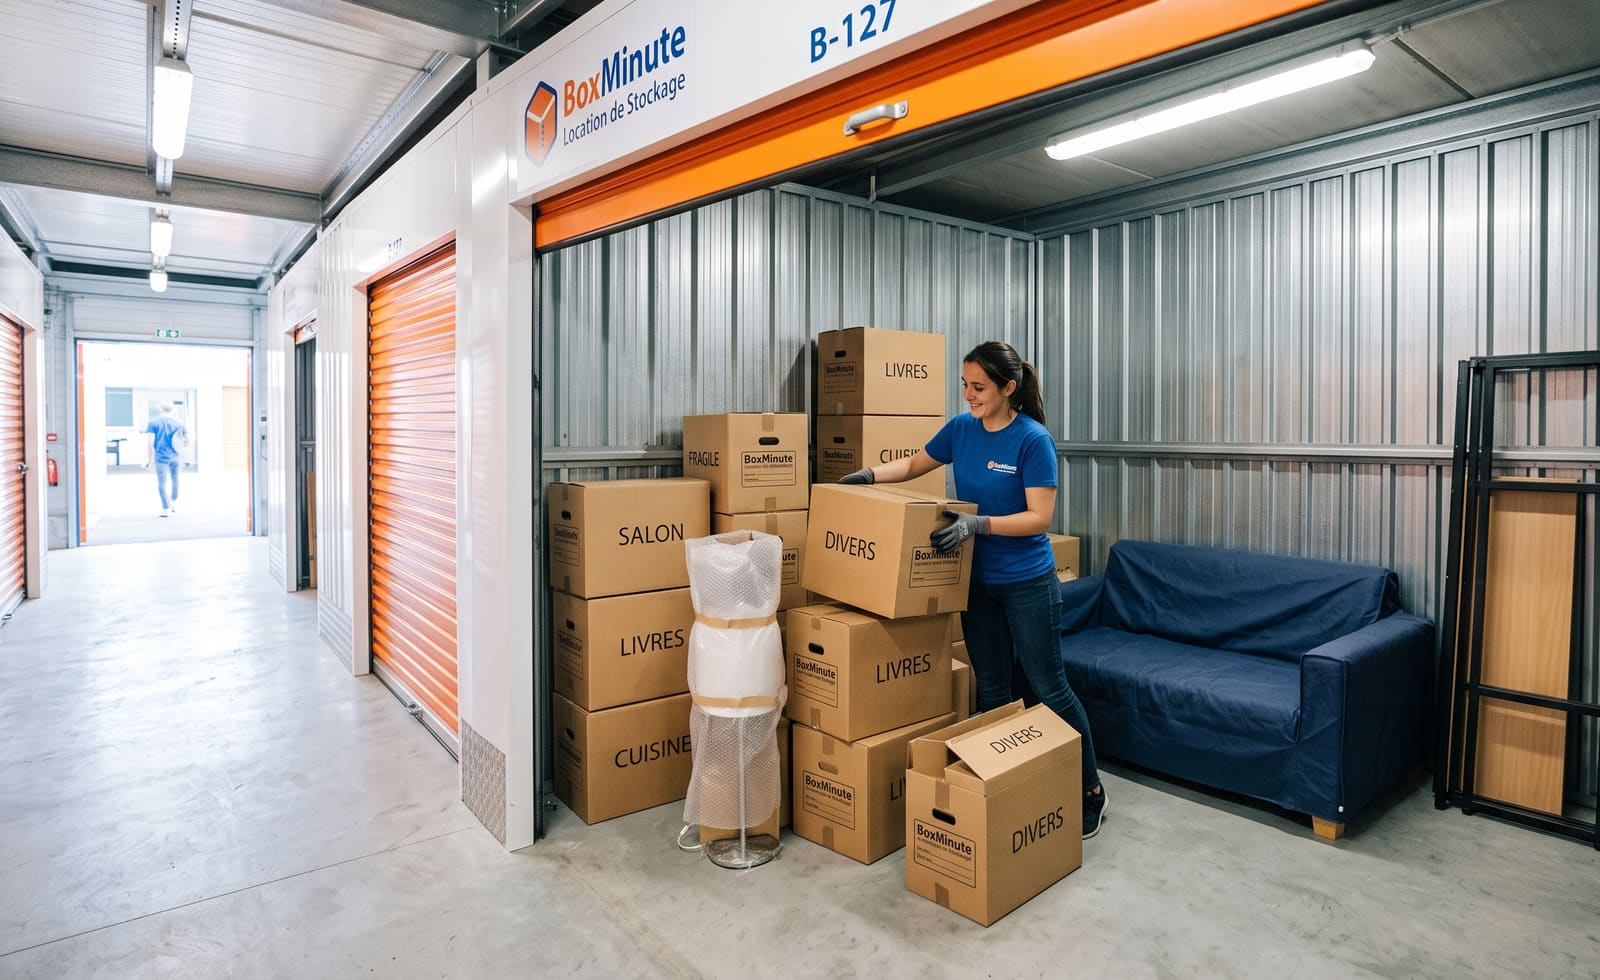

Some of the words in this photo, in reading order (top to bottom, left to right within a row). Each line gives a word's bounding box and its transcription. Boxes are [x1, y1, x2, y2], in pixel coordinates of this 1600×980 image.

[811, 0, 896, 63] B-127
[563, 25, 686, 117] BoxMinute
[563, 111, 607, 146] Location
[610, 100, 625, 122] de
[627, 73, 686, 115] Stockage
[885, 362, 928, 379] LIVRES
[688, 451, 720, 467] FRAGILE
[744, 454, 793, 464] BoxMinute
[618, 523, 684, 546] SALON
[825, 530, 876, 561] DIVERS
[621, 629, 685, 656] LIVRES
[796, 658, 836, 679] BoxMinute
[876, 653, 931, 684] LIVRES
[615, 735, 692, 768] CUISINE
[989, 725, 1043, 754] DIVERS
[805, 775, 852, 800] BoxMinute
[917, 824, 972, 855] BoxMinute
[1012, 806, 1064, 854] DIVERS
